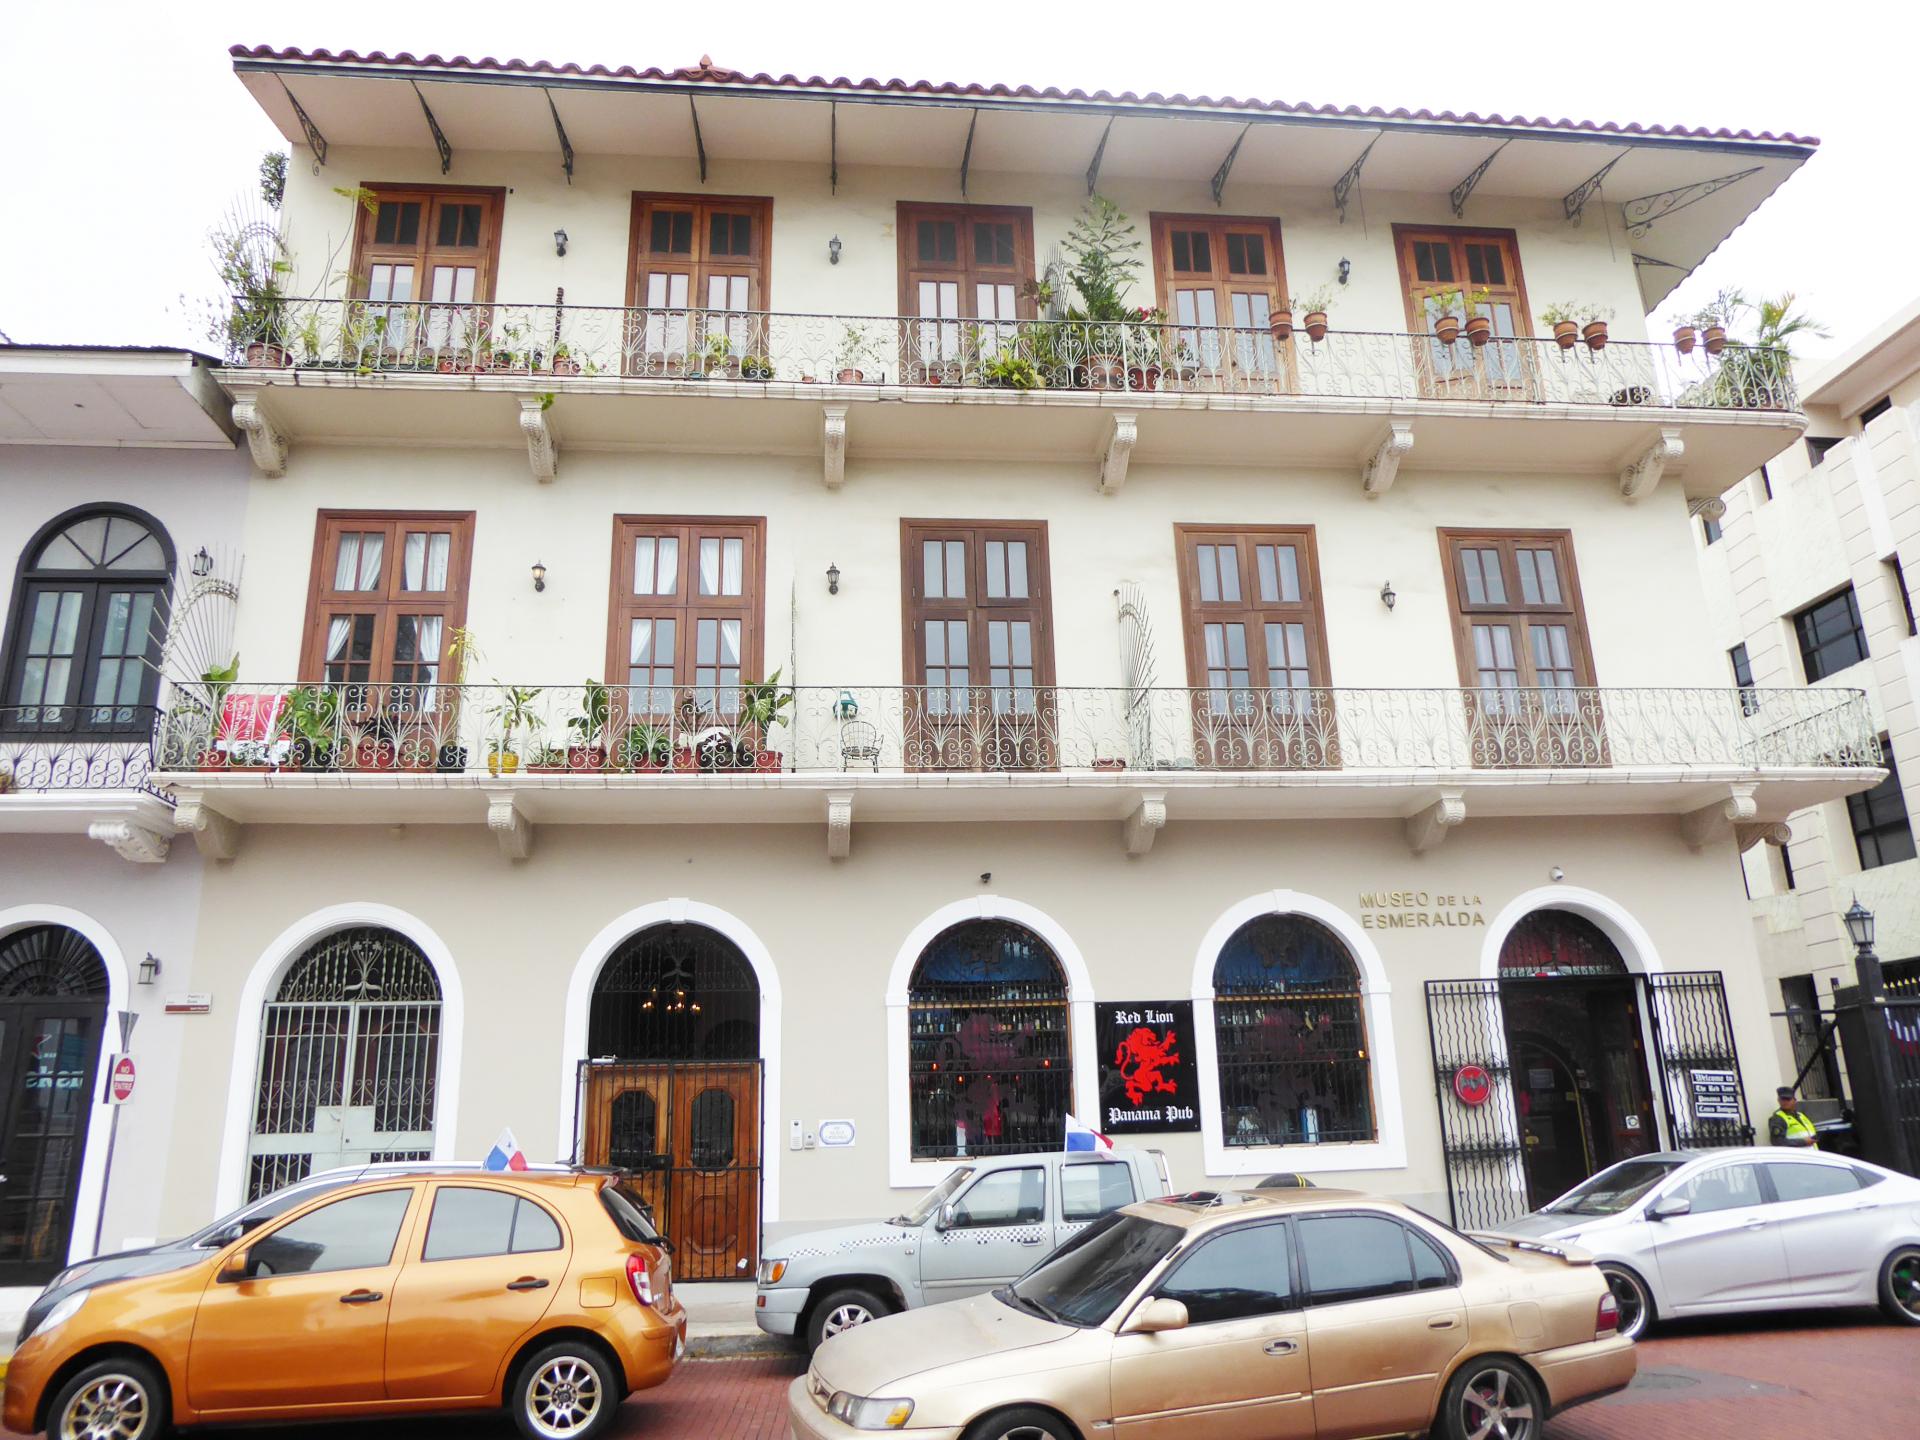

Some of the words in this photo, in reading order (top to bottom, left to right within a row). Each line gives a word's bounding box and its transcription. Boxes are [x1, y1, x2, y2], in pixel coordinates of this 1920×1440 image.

[1359, 892, 1429, 908] MUSEO
[1437, 895, 1456, 906] DE
[1462, 895, 1482, 906] LA
[1361, 911, 1486, 929] ESMERALDA
[1115, 1010, 1141, 1024] Red
[1144, 1009, 1174, 1024] Lion
[1108, 1107, 1161, 1125] Panama
[1165, 1105, 1194, 1123] Pub
